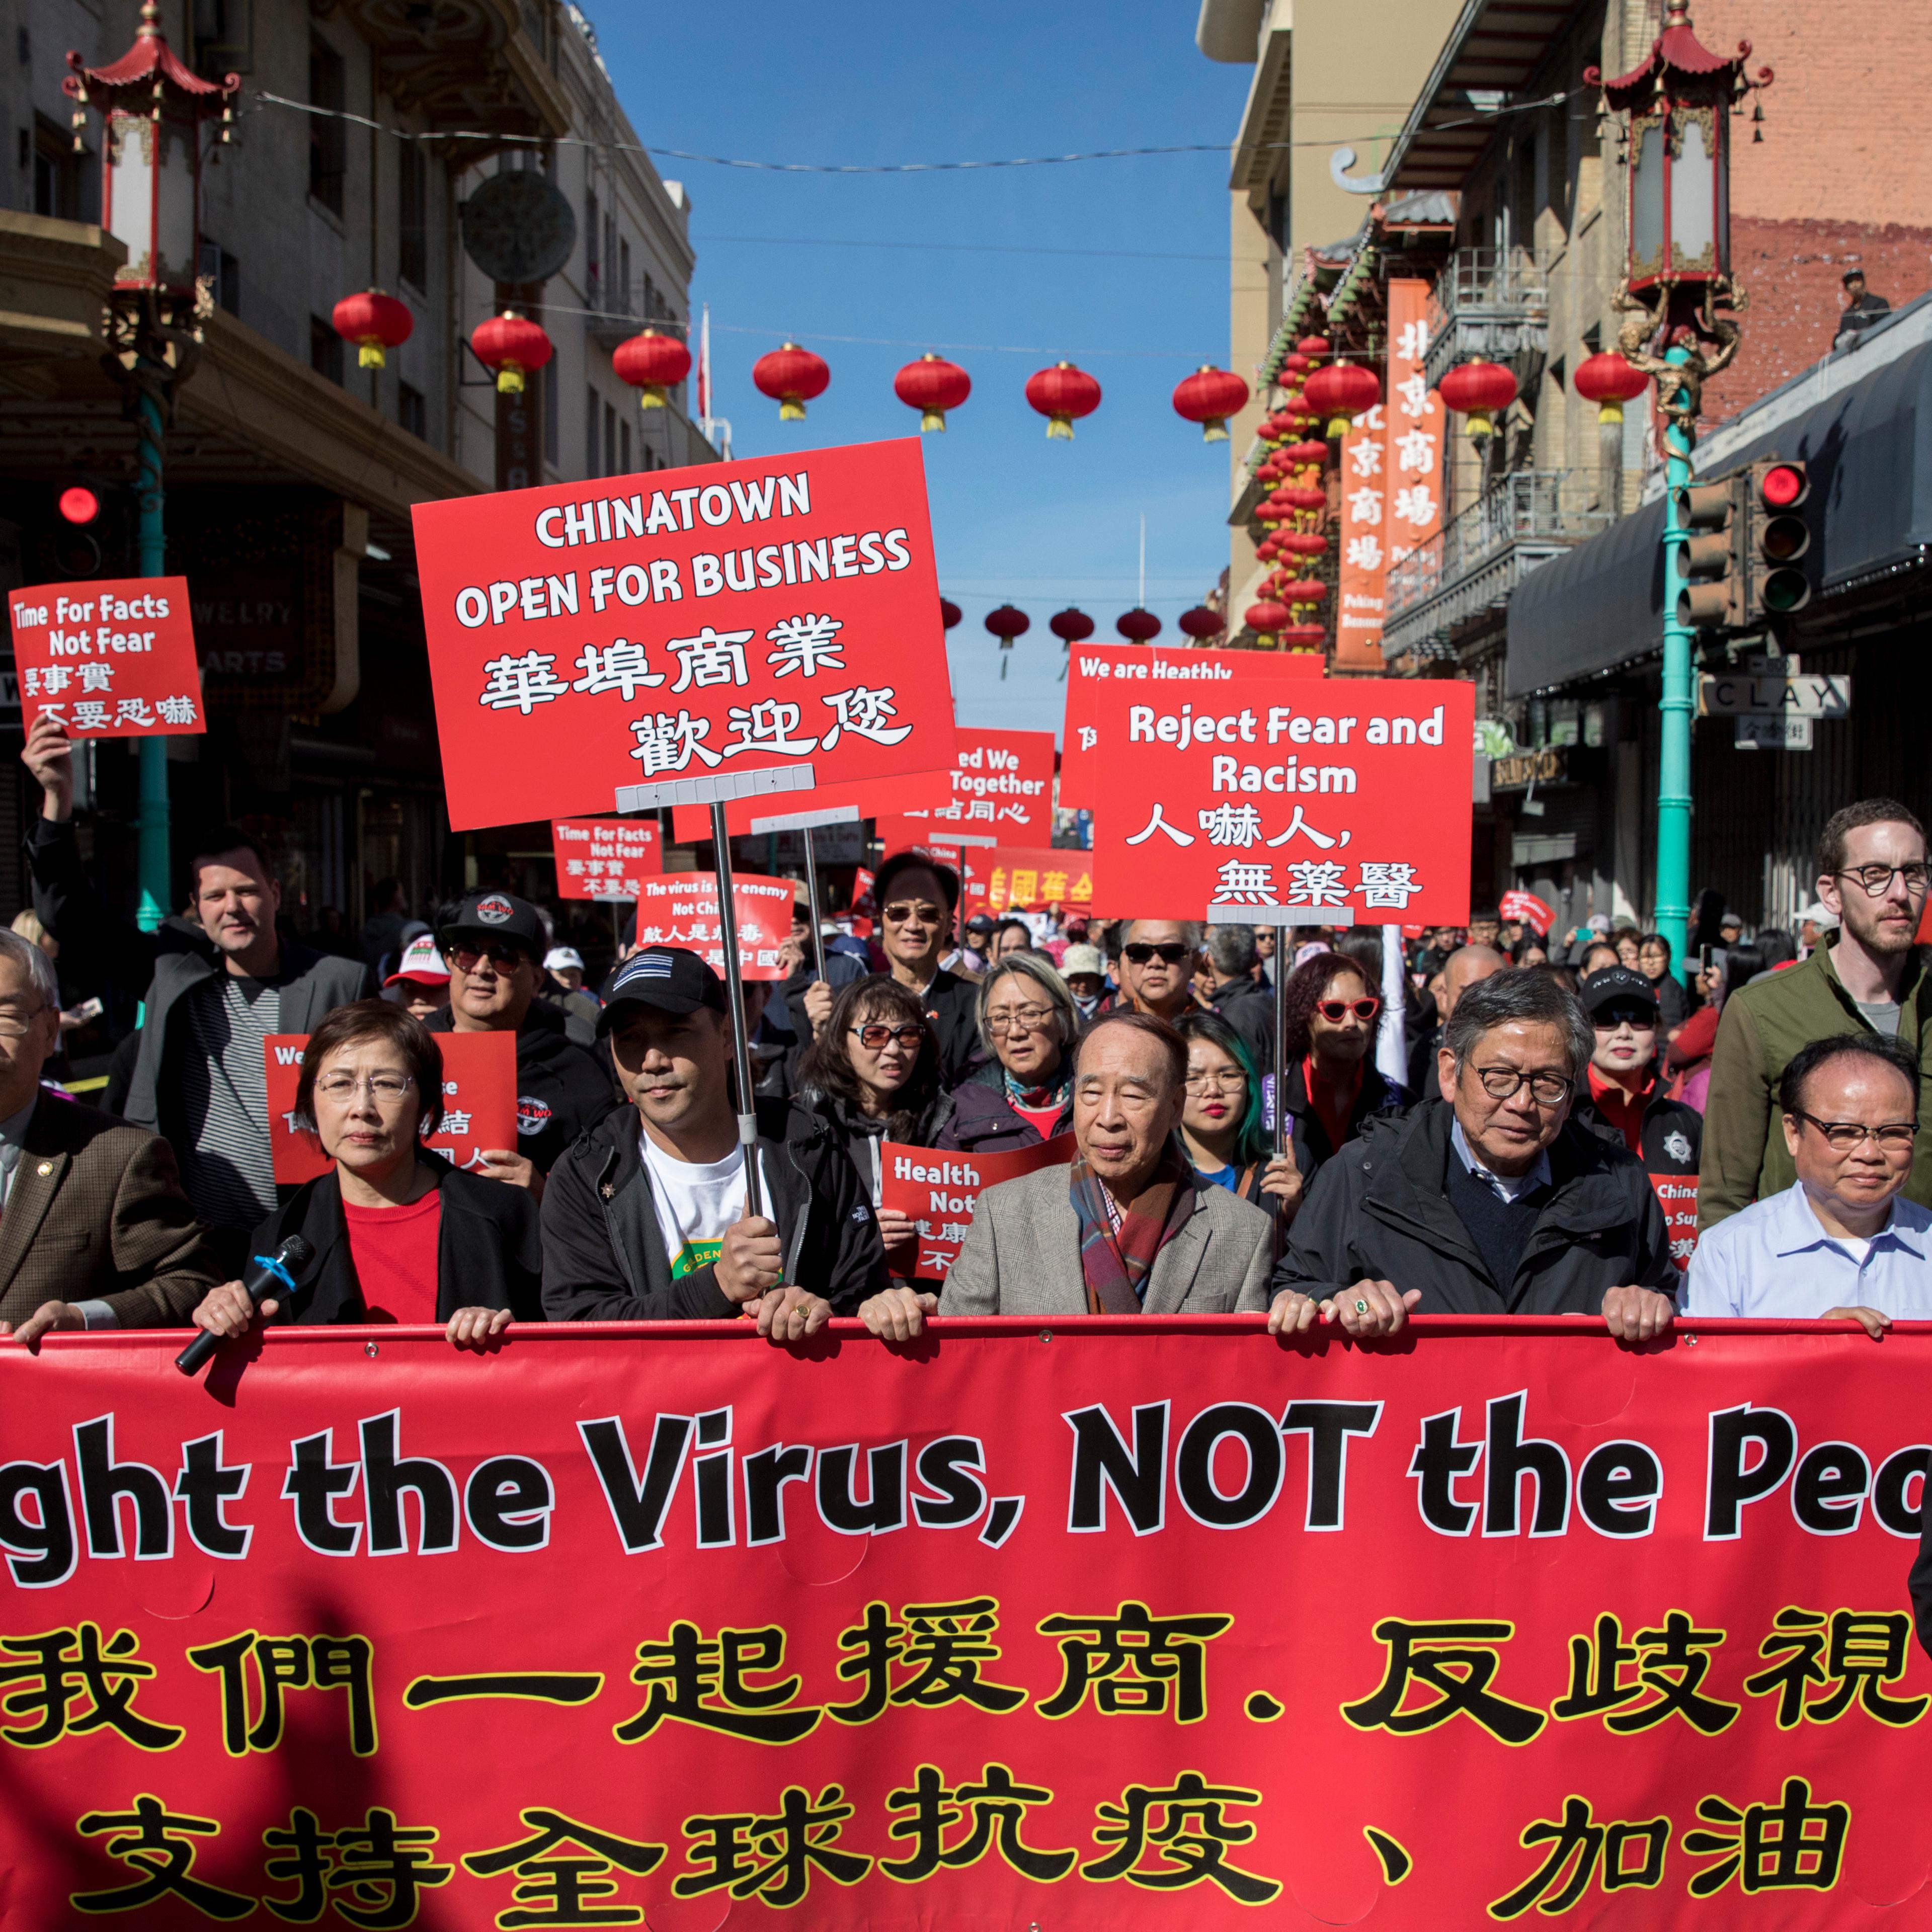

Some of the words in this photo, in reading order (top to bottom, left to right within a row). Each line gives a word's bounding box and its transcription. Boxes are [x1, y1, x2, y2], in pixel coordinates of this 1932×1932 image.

[534, 470, 811, 549] CHINATOWN
[455, 571, 580, 629] OPEN
[590, 557, 683, 613] FOR
[692, 528, 911, 598] BUSINESS
[14, 601, 48, 629] Time
[55, 595, 96, 624] For
[100, 593, 171, 621] Facts
[48, 629, 92, 657] Not
[96, 626, 156, 655] Fear
[478, 612, 846, 715] 華埠商業
[1079, 656, 1110, 678] We
[1113, 662, 1148, 679] are
[24, 661, 116, 698] 要事實
[1716, 683, 1831, 707] CLAY
[37, 694, 199, 732] 不要恐嚇
[1129, 703, 1258, 752] Reject
[1265, 705, 1357, 746] Fear
[1365, 704, 1445, 747] and
[628, 686, 914, 776] 歡迎您
[986, 748, 1020, 771] We
[1211, 754, 1358, 794] Racism
[949, 770, 1045, 797] Together
[556, 825, 590, 841] Time
[593, 826, 616, 842] For
[616, 827, 653, 842] Facts
[590, 842, 615, 857] Not
[615, 843, 646, 858] Fear
[646, 882, 666, 897] The
[668, 880, 699, 894] virus
[701, 879, 713, 894] is
[741, 883, 788, 901] enemy
[672, 902, 695, 916] Not
[274, 1045, 305, 1066] We
[894, 1156, 981, 1187] Health
[929, 1190, 976, 1214] Not
[1656, 1183, 1698, 1199] China
[920, 1249, 955, 1271] 不
[0, 1411, 255, 1589] ght
[280, 1407, 556, 1559] the
[576, 1405, 1025, 1556] Virus,
[1060, 1398, 1385, 1538] NOT
[1405, 1388, 1664, 1540] the
